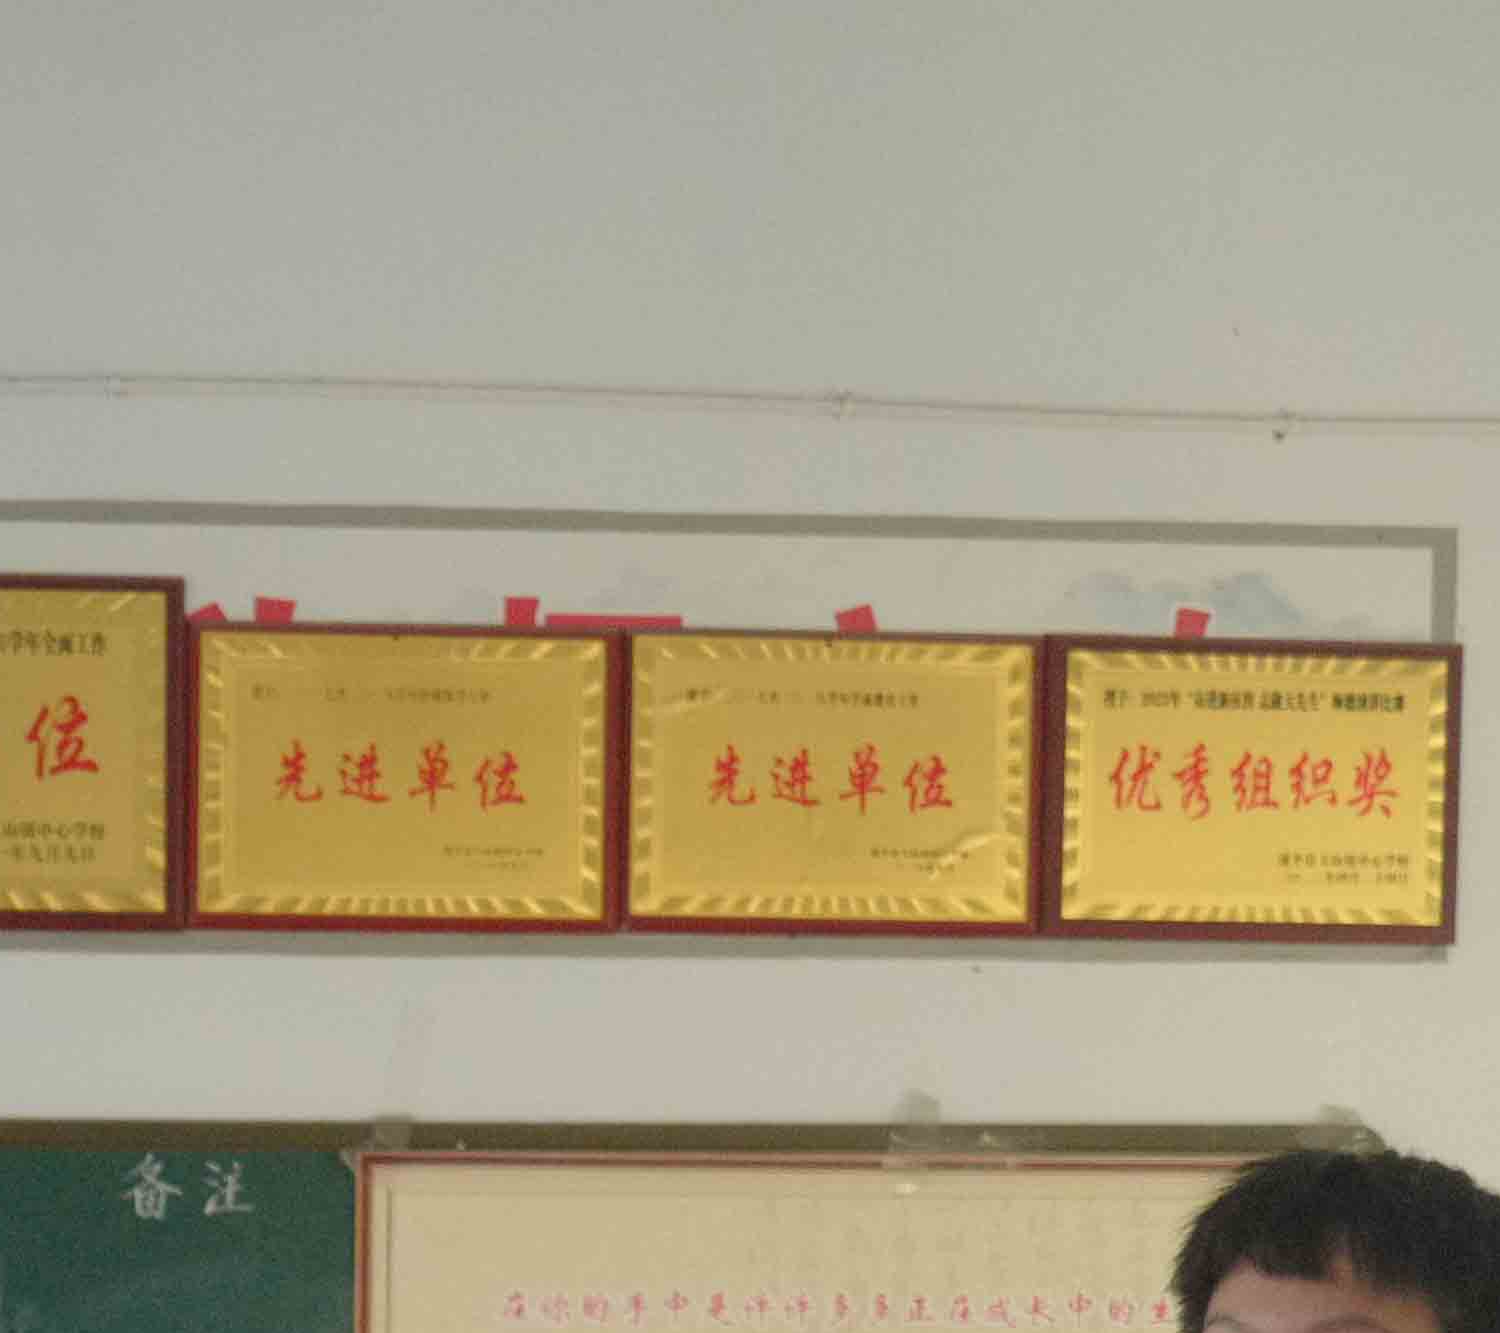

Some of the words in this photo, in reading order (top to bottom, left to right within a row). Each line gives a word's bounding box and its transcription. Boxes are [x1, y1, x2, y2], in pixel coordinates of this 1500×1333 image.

[276, 739, 525, 813] 先进单位
[708, 743, 953, 815] 先进单位
[1109, 743, 1401, 821] 优秀组织奖
[118, 1152, 256, 1221] 备注
